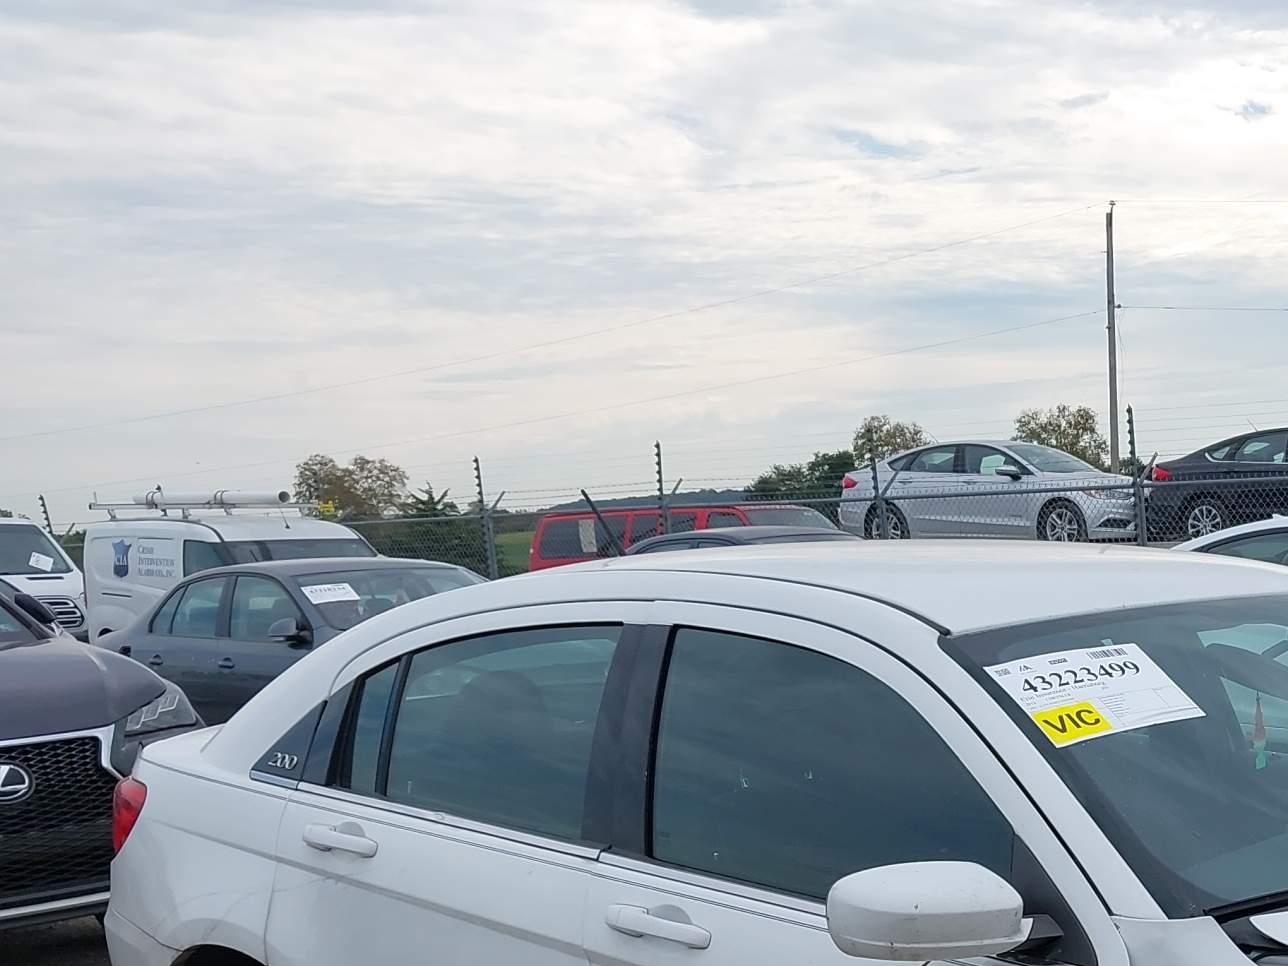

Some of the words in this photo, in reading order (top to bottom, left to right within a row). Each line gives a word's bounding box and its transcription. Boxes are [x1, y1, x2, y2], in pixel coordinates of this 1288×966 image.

[1022, 660, 1140, 693] 43223499
[1042, 709, 1101, 734] VIC
[268, 751, 297, 770] 200
